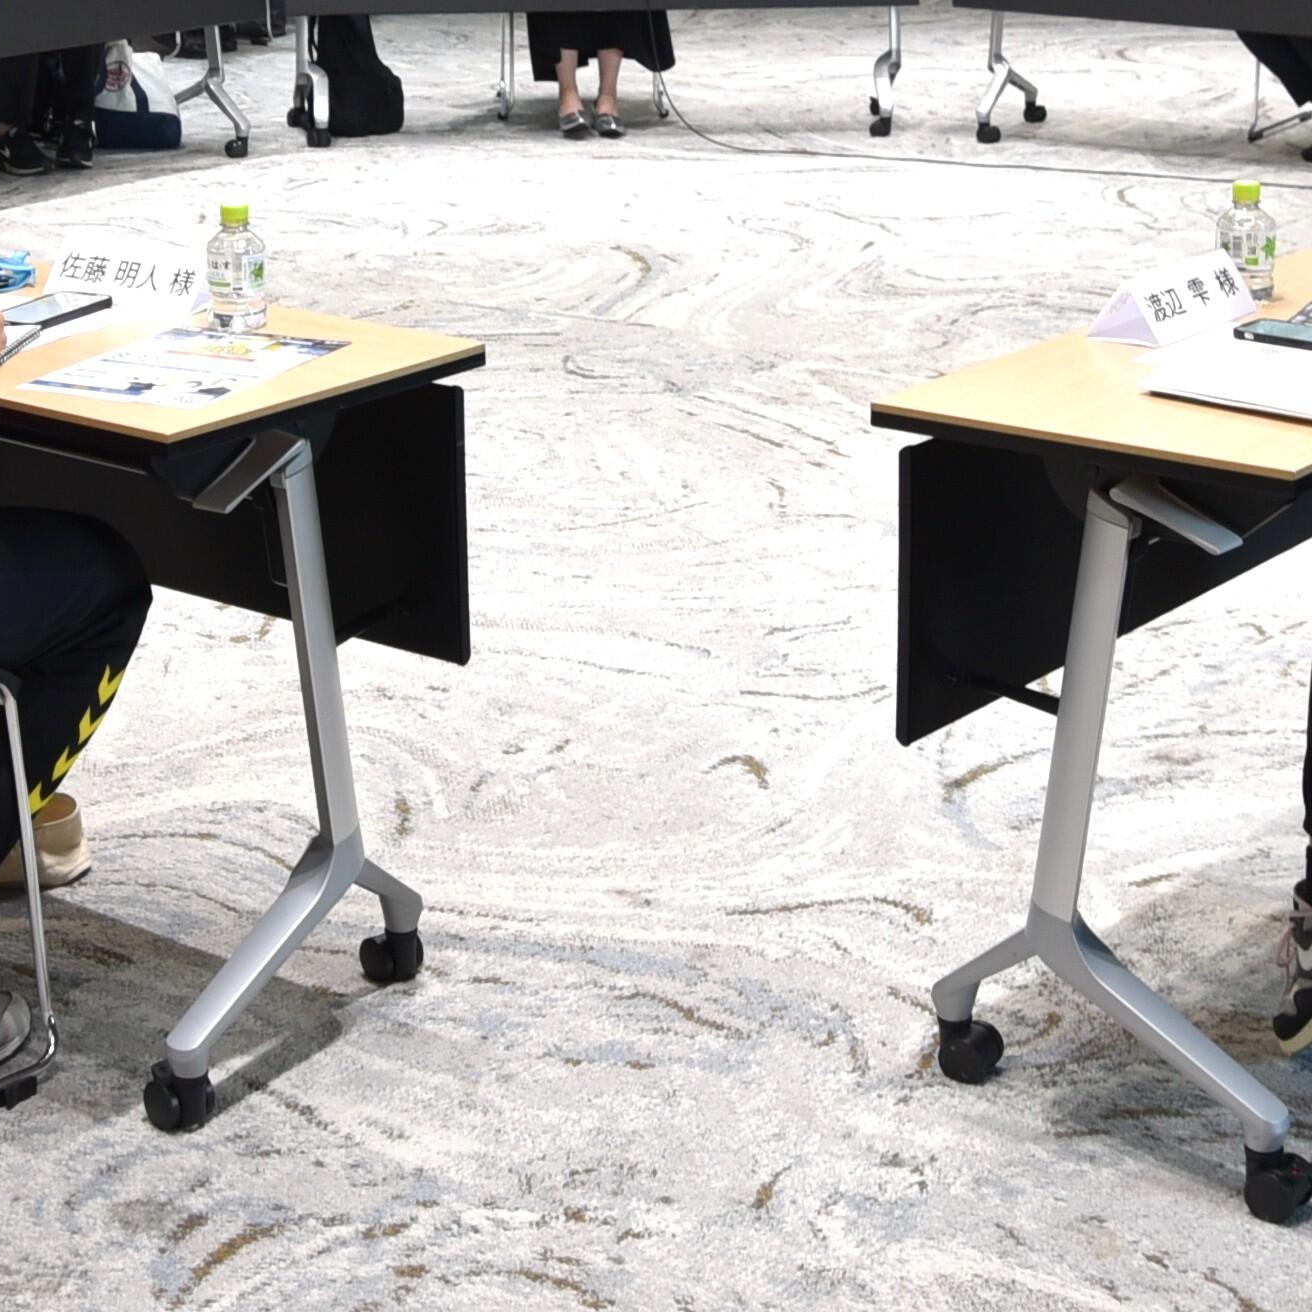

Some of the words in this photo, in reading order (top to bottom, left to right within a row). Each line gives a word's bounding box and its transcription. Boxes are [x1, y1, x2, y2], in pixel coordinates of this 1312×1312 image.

[60, 252, 110, 283] 佐藤
[114, 260, 157, 291] 明人
[169, 268, 196, 296] 様
[1143, 288, 1187, 322] 渡辺
[1187, 277, 1210, 306] 雫
[1213, 267, 1240, 297] 様
